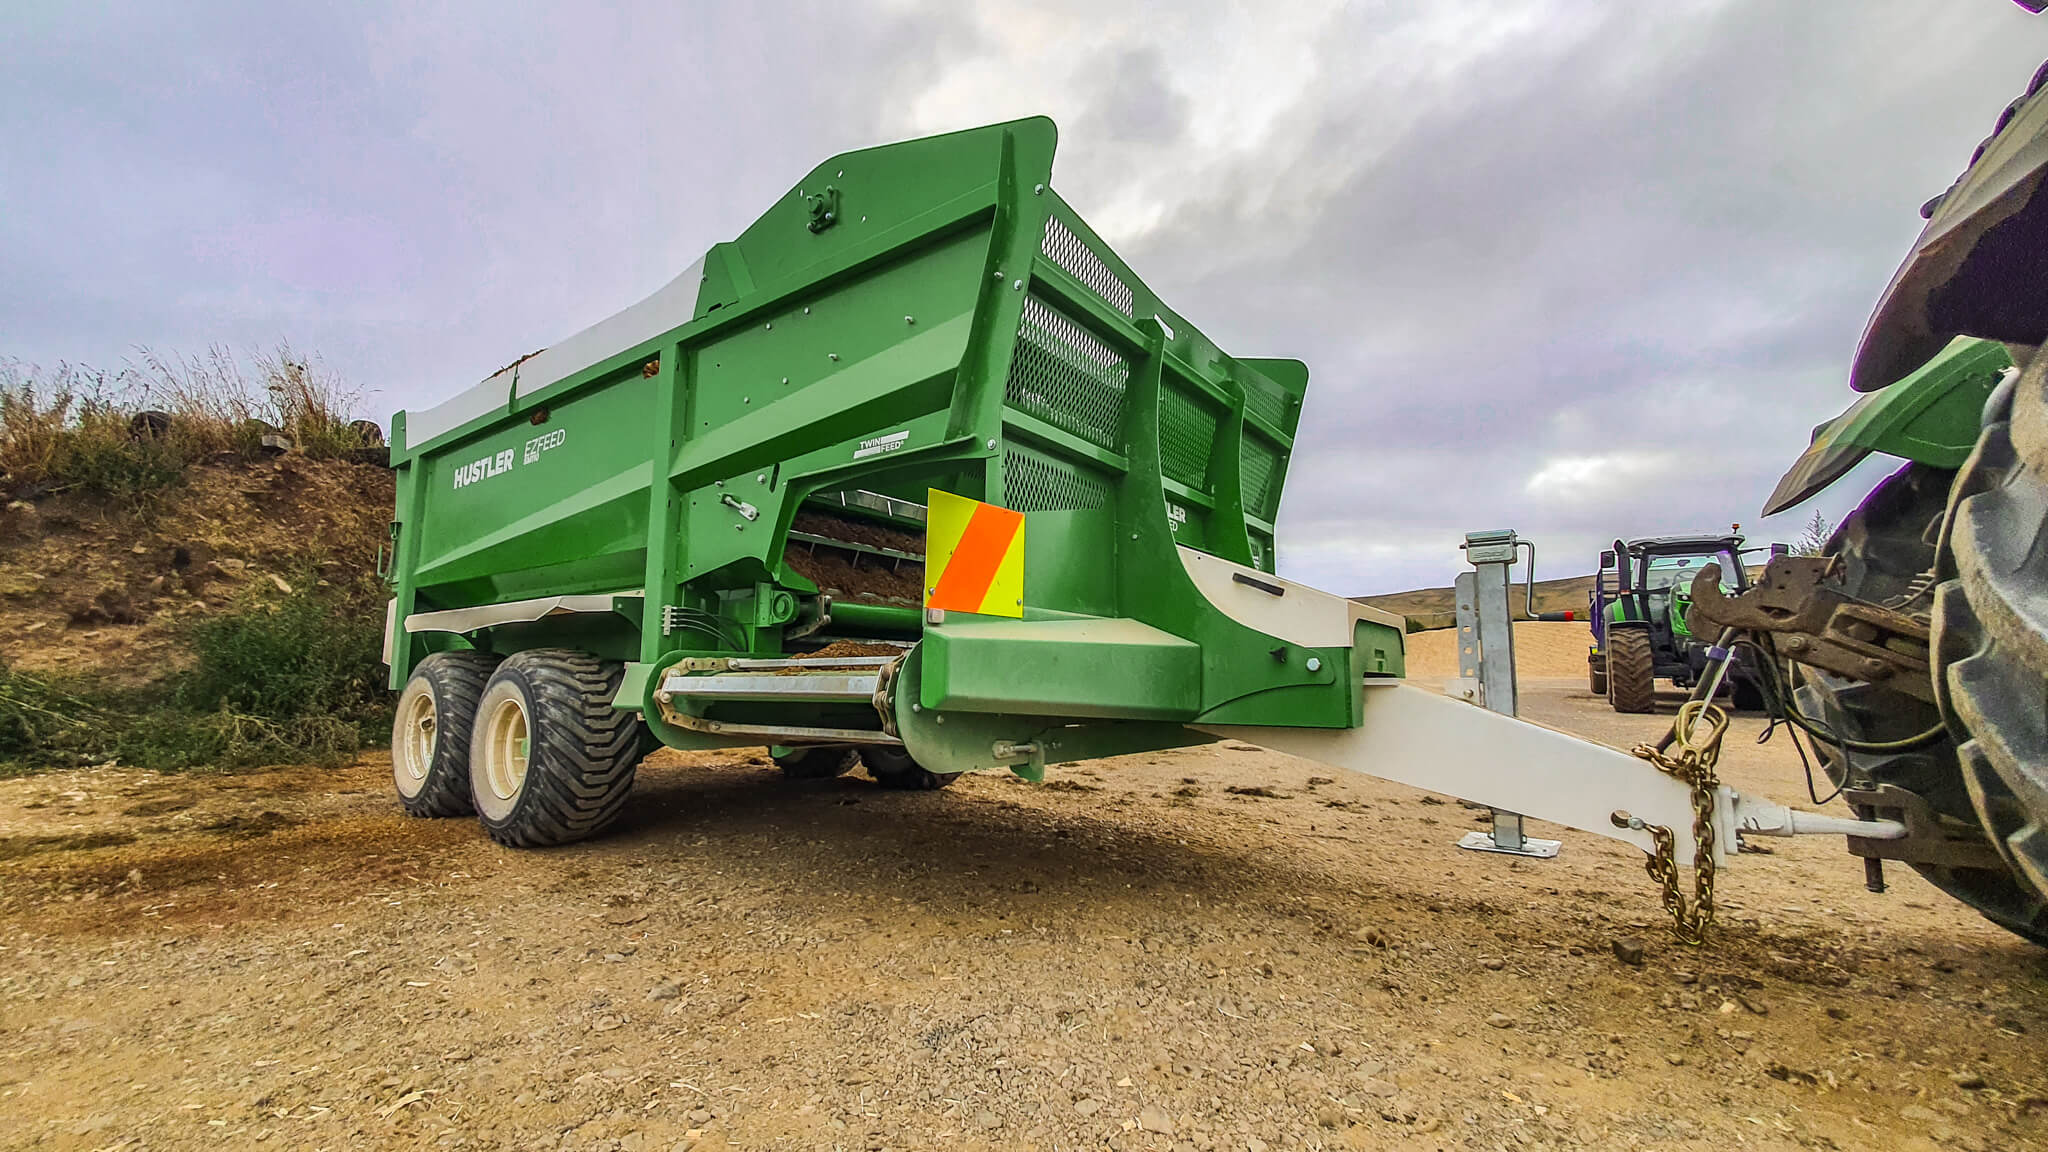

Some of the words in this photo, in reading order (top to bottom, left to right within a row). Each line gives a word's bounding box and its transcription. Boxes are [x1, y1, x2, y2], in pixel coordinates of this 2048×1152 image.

[524, 429, 566, 457] EZFEED
[859, 437, 881, 450] TWIN
[453, 448, 515, 489] HUSTLER
